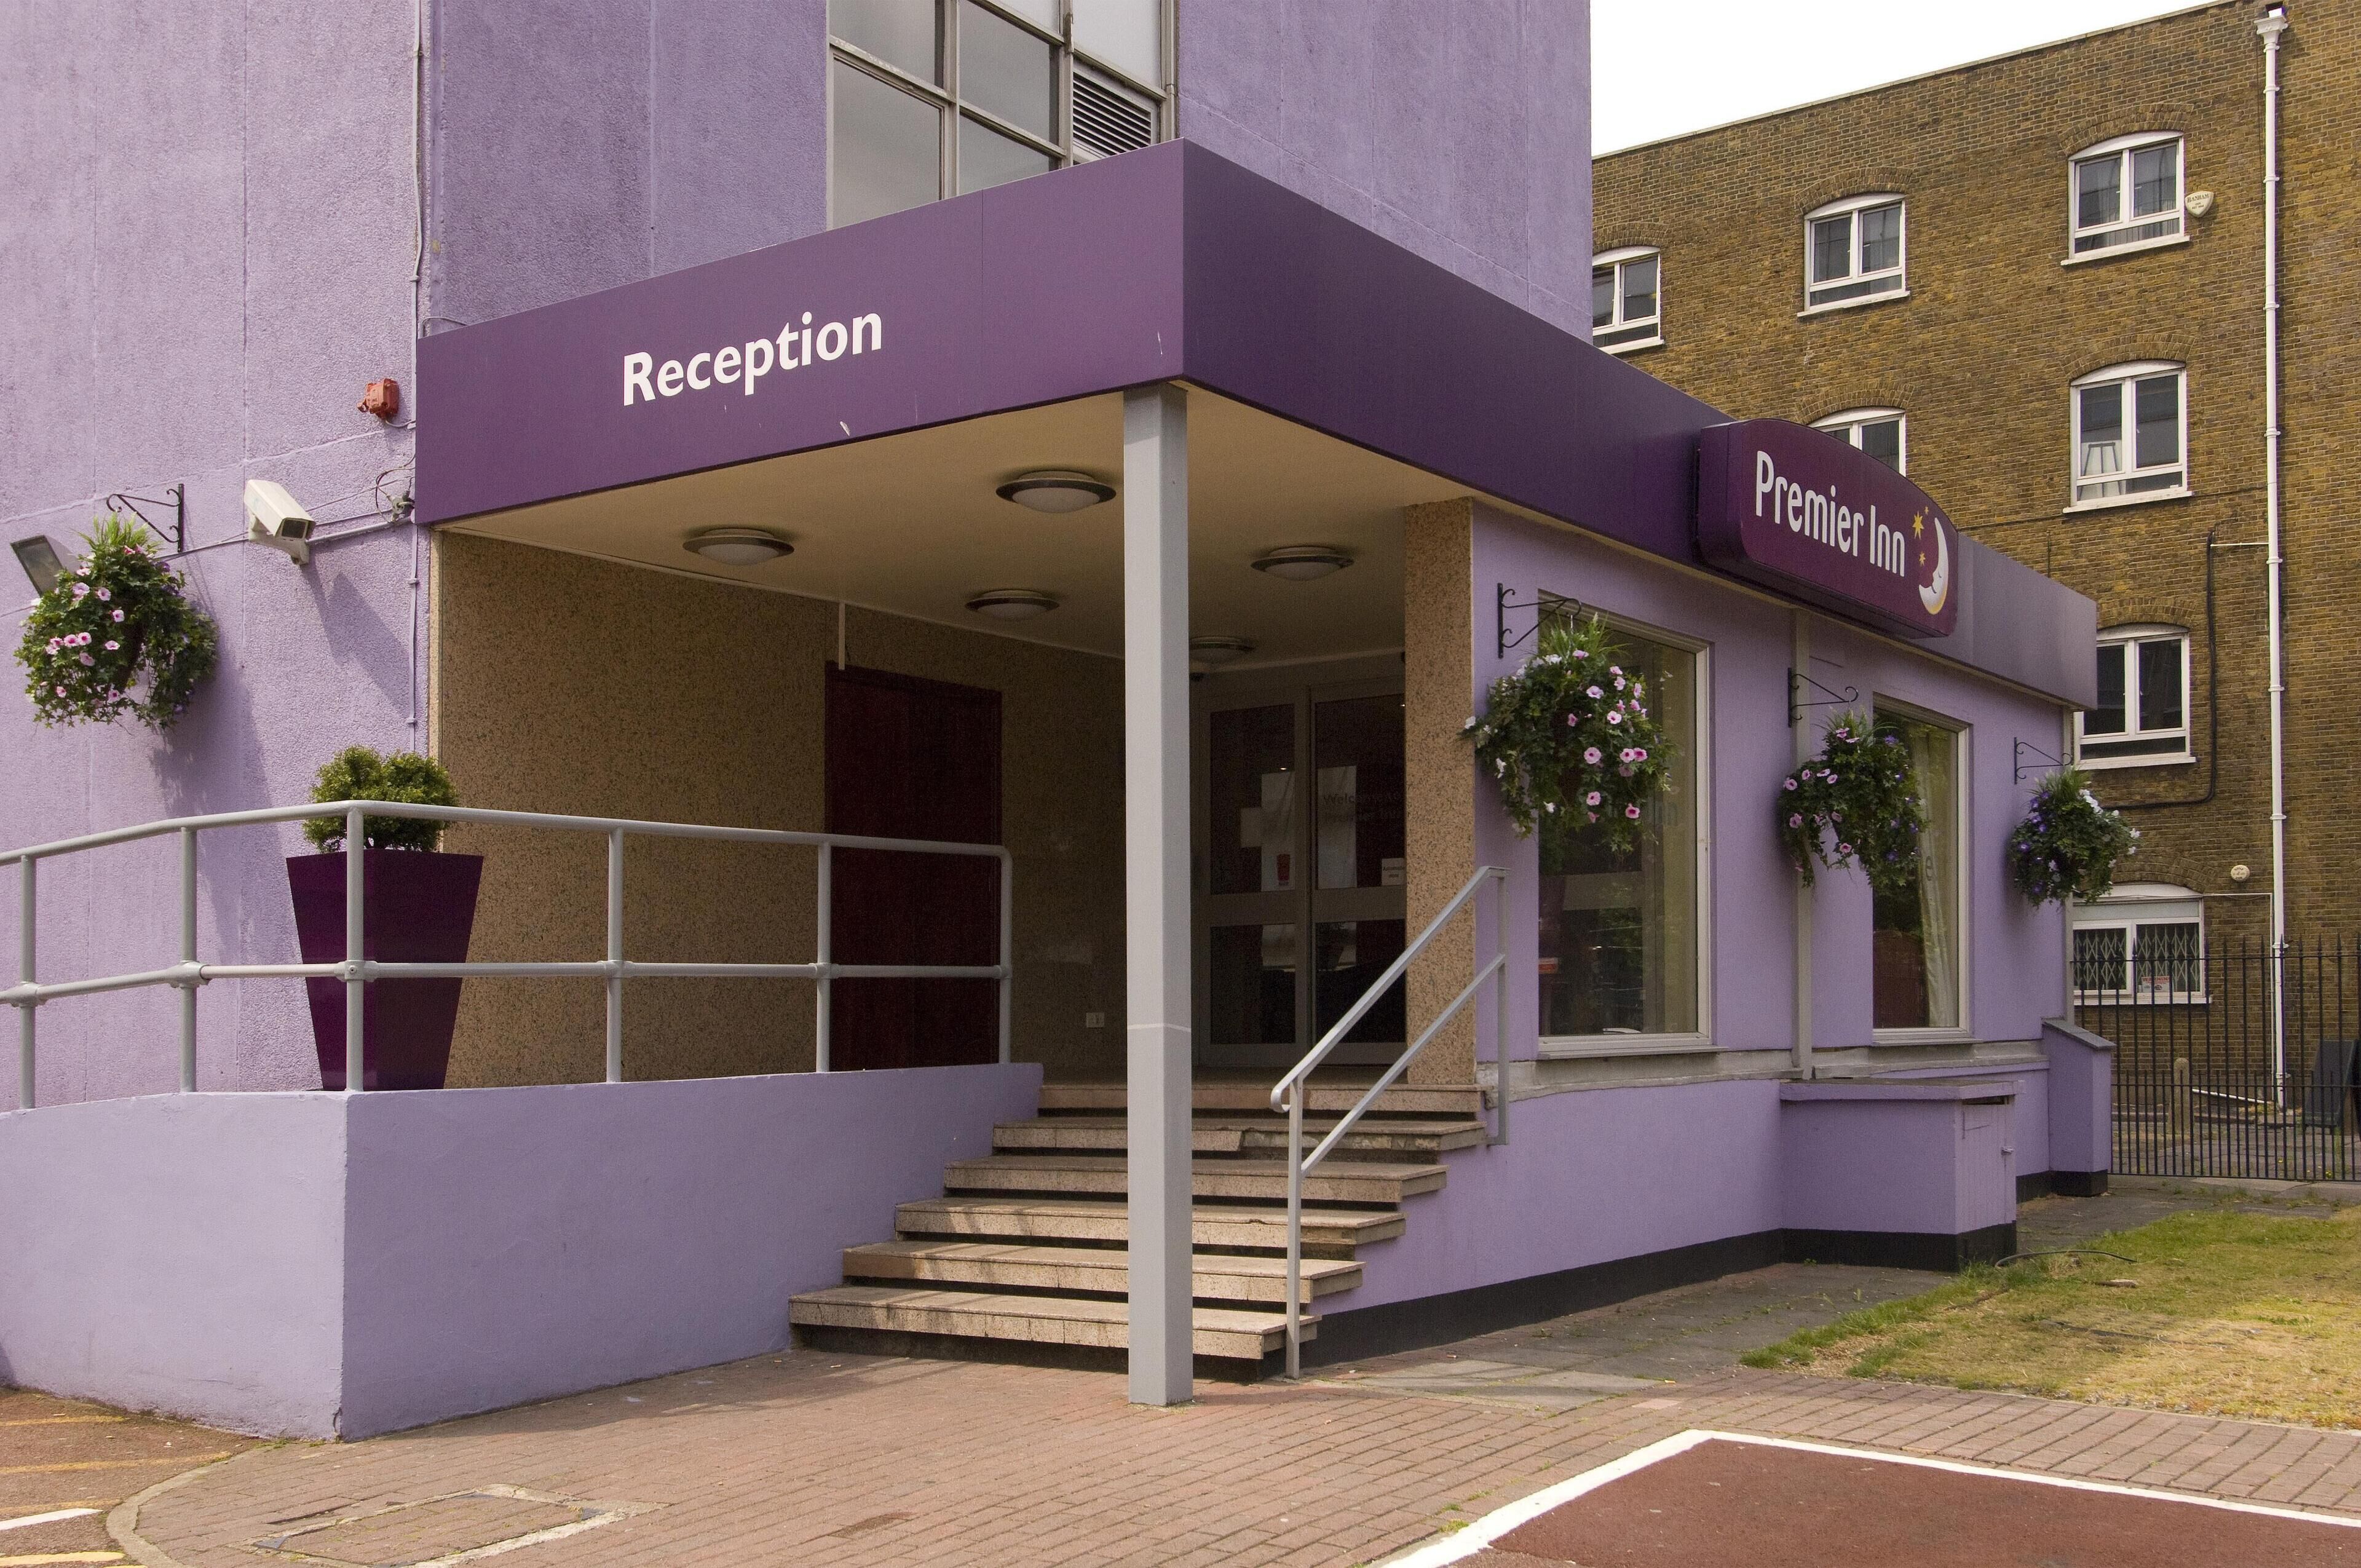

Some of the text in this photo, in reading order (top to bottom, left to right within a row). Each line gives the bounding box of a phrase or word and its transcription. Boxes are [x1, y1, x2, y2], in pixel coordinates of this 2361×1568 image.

[623, 311, 882, 406] Reception
[1756, 450, 1905, 577] Premier Inn
